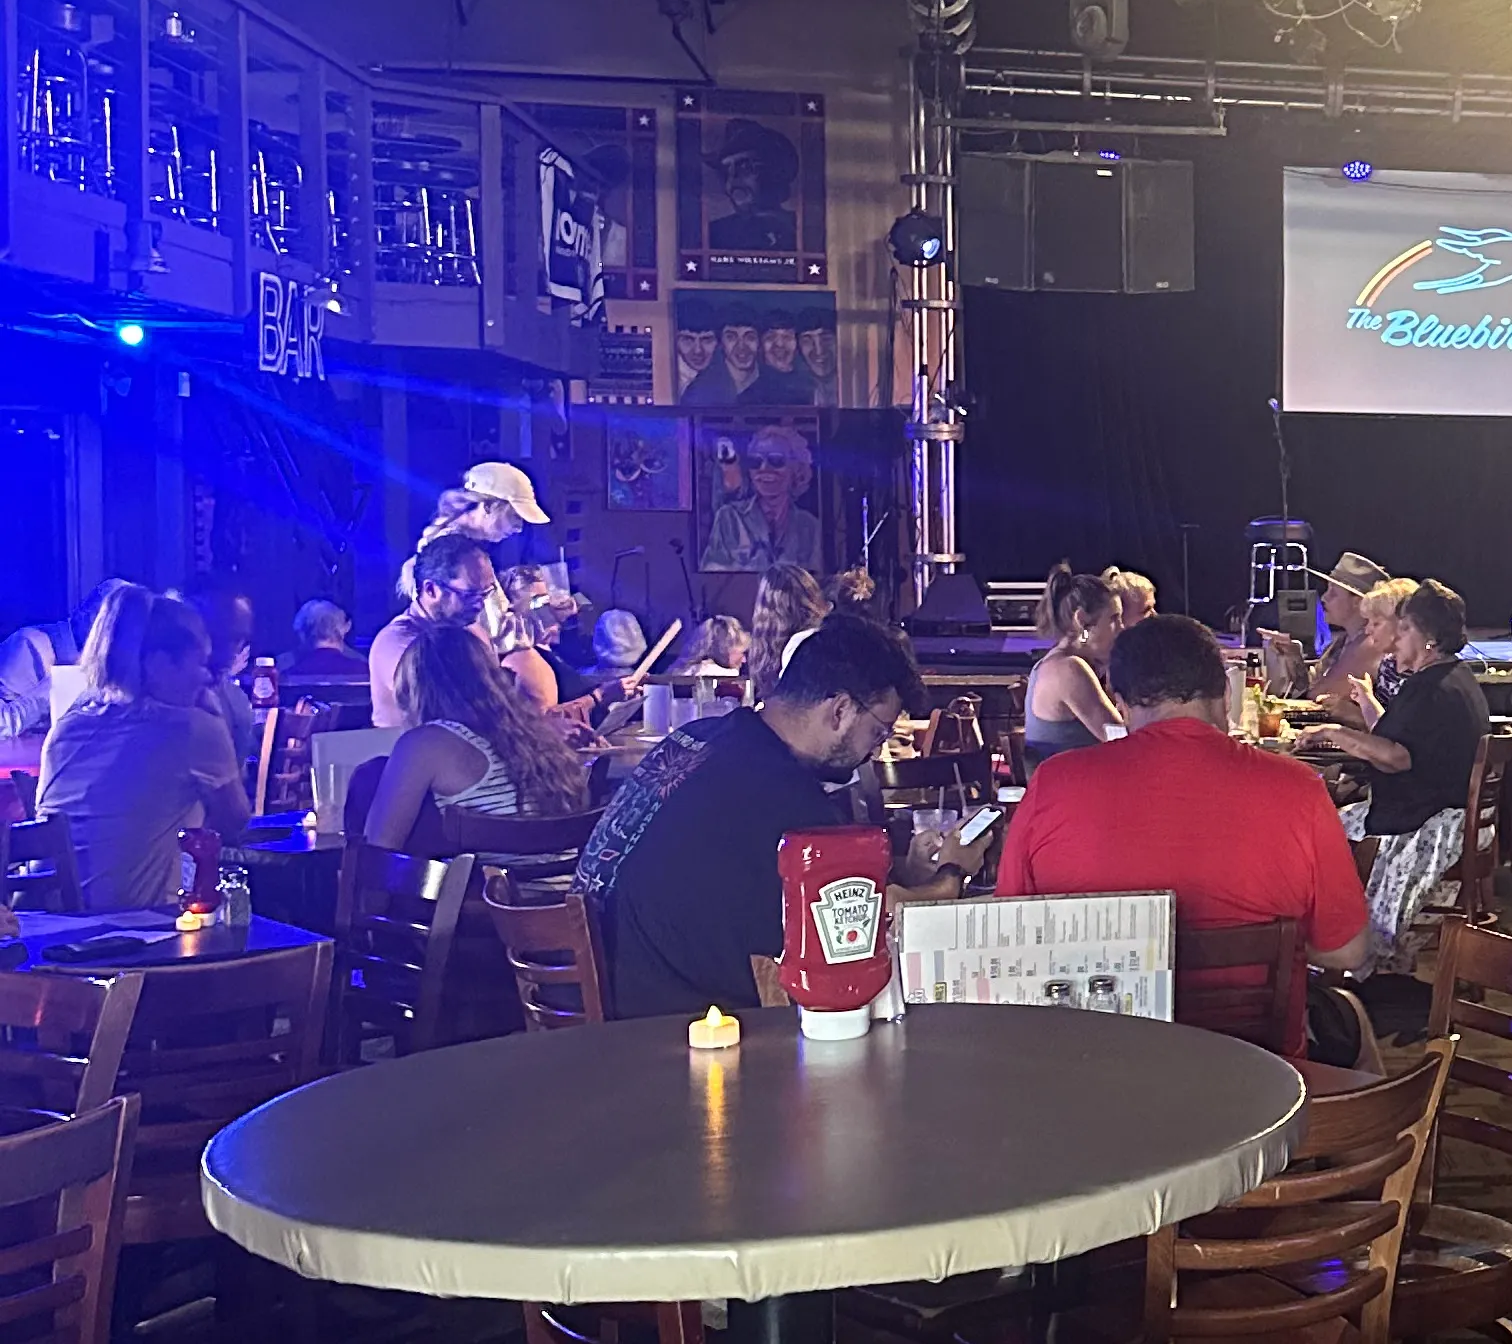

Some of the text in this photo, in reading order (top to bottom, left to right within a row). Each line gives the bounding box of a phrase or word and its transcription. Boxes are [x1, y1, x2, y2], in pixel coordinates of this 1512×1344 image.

[259, 271, 326, 381] BAR
[1346, 307, 1383, 331] The
[833, 887, 866, 901] HEINZ
[832, 903, 869, 917] TOMATO
